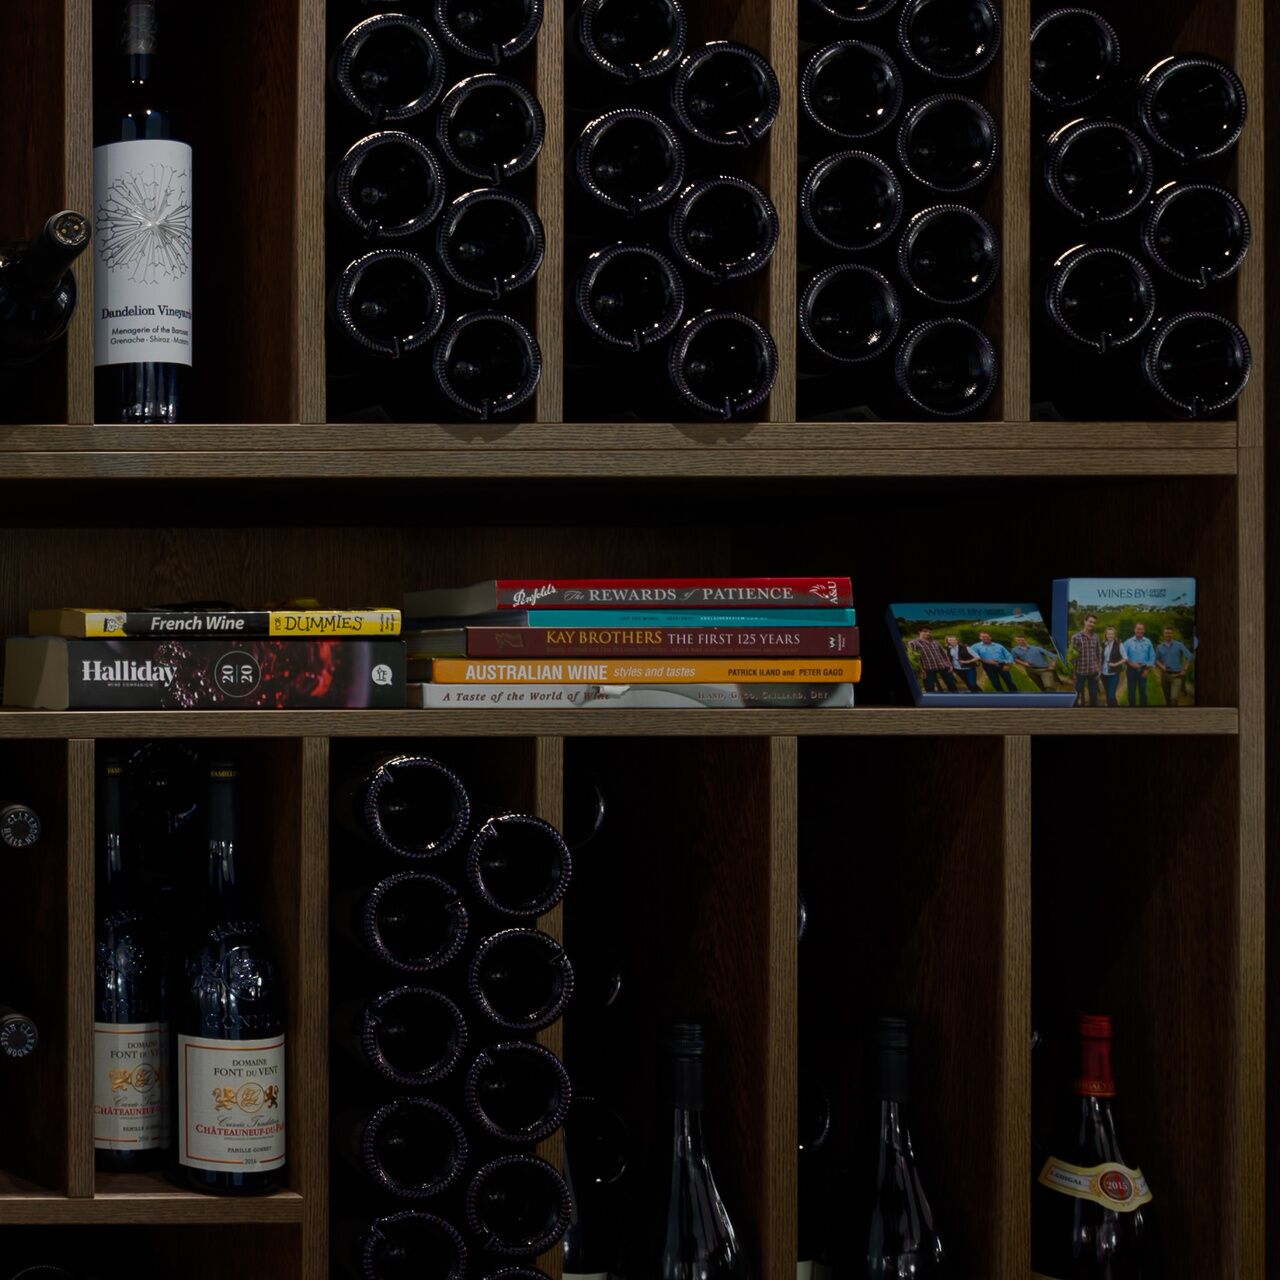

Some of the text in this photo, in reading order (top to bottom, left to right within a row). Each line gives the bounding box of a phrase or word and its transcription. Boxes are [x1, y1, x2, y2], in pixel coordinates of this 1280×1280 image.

[101, 305, 155, 320] Dandelion
[111, 327, 150, 336] Menagerie
[110, 336, 170, 345] Grenache Shiraz
[512, 584, 557, 608] Penfolds
[590, 589, 676, 602] REWARDS
[703, 587, 794, 601] PATIENCE
[829, 581, 838, 605] A&U
[1097, 588, 1146, 598] WINES BY
[150, 616, 245, 631] French Wine
[284, 615, 363, 632] DUMMIES
[546, 631, 801, 645] KAY BROTHERS THE FIRST 125 YEARS
[82, 660, 178, 687] Halliday
[222, 664, 234, 683] 20
[241, 664, 253, 683] 20
[465, 665, 695, 681] AUSTRALIAN WINE styles and tastes
[728, 669, 757, 677] PATRICK
[759, 669, 780, 677] ILAND
[443, 693, 450, 701] A
[456, 693, 487, 701] Taste
[490, 692, 502, 702] of
[507, 692, 525, 701] the
[530, 692, 562, 701] World
[567, 692, 579, 702] of
[110, 1050, 137, 1059] FONT
[232, 1059, 267, 1067] DOMAINE
[214, 1068, 244, 1077] FONT
[259, 1065, 279, 1076] VENT
